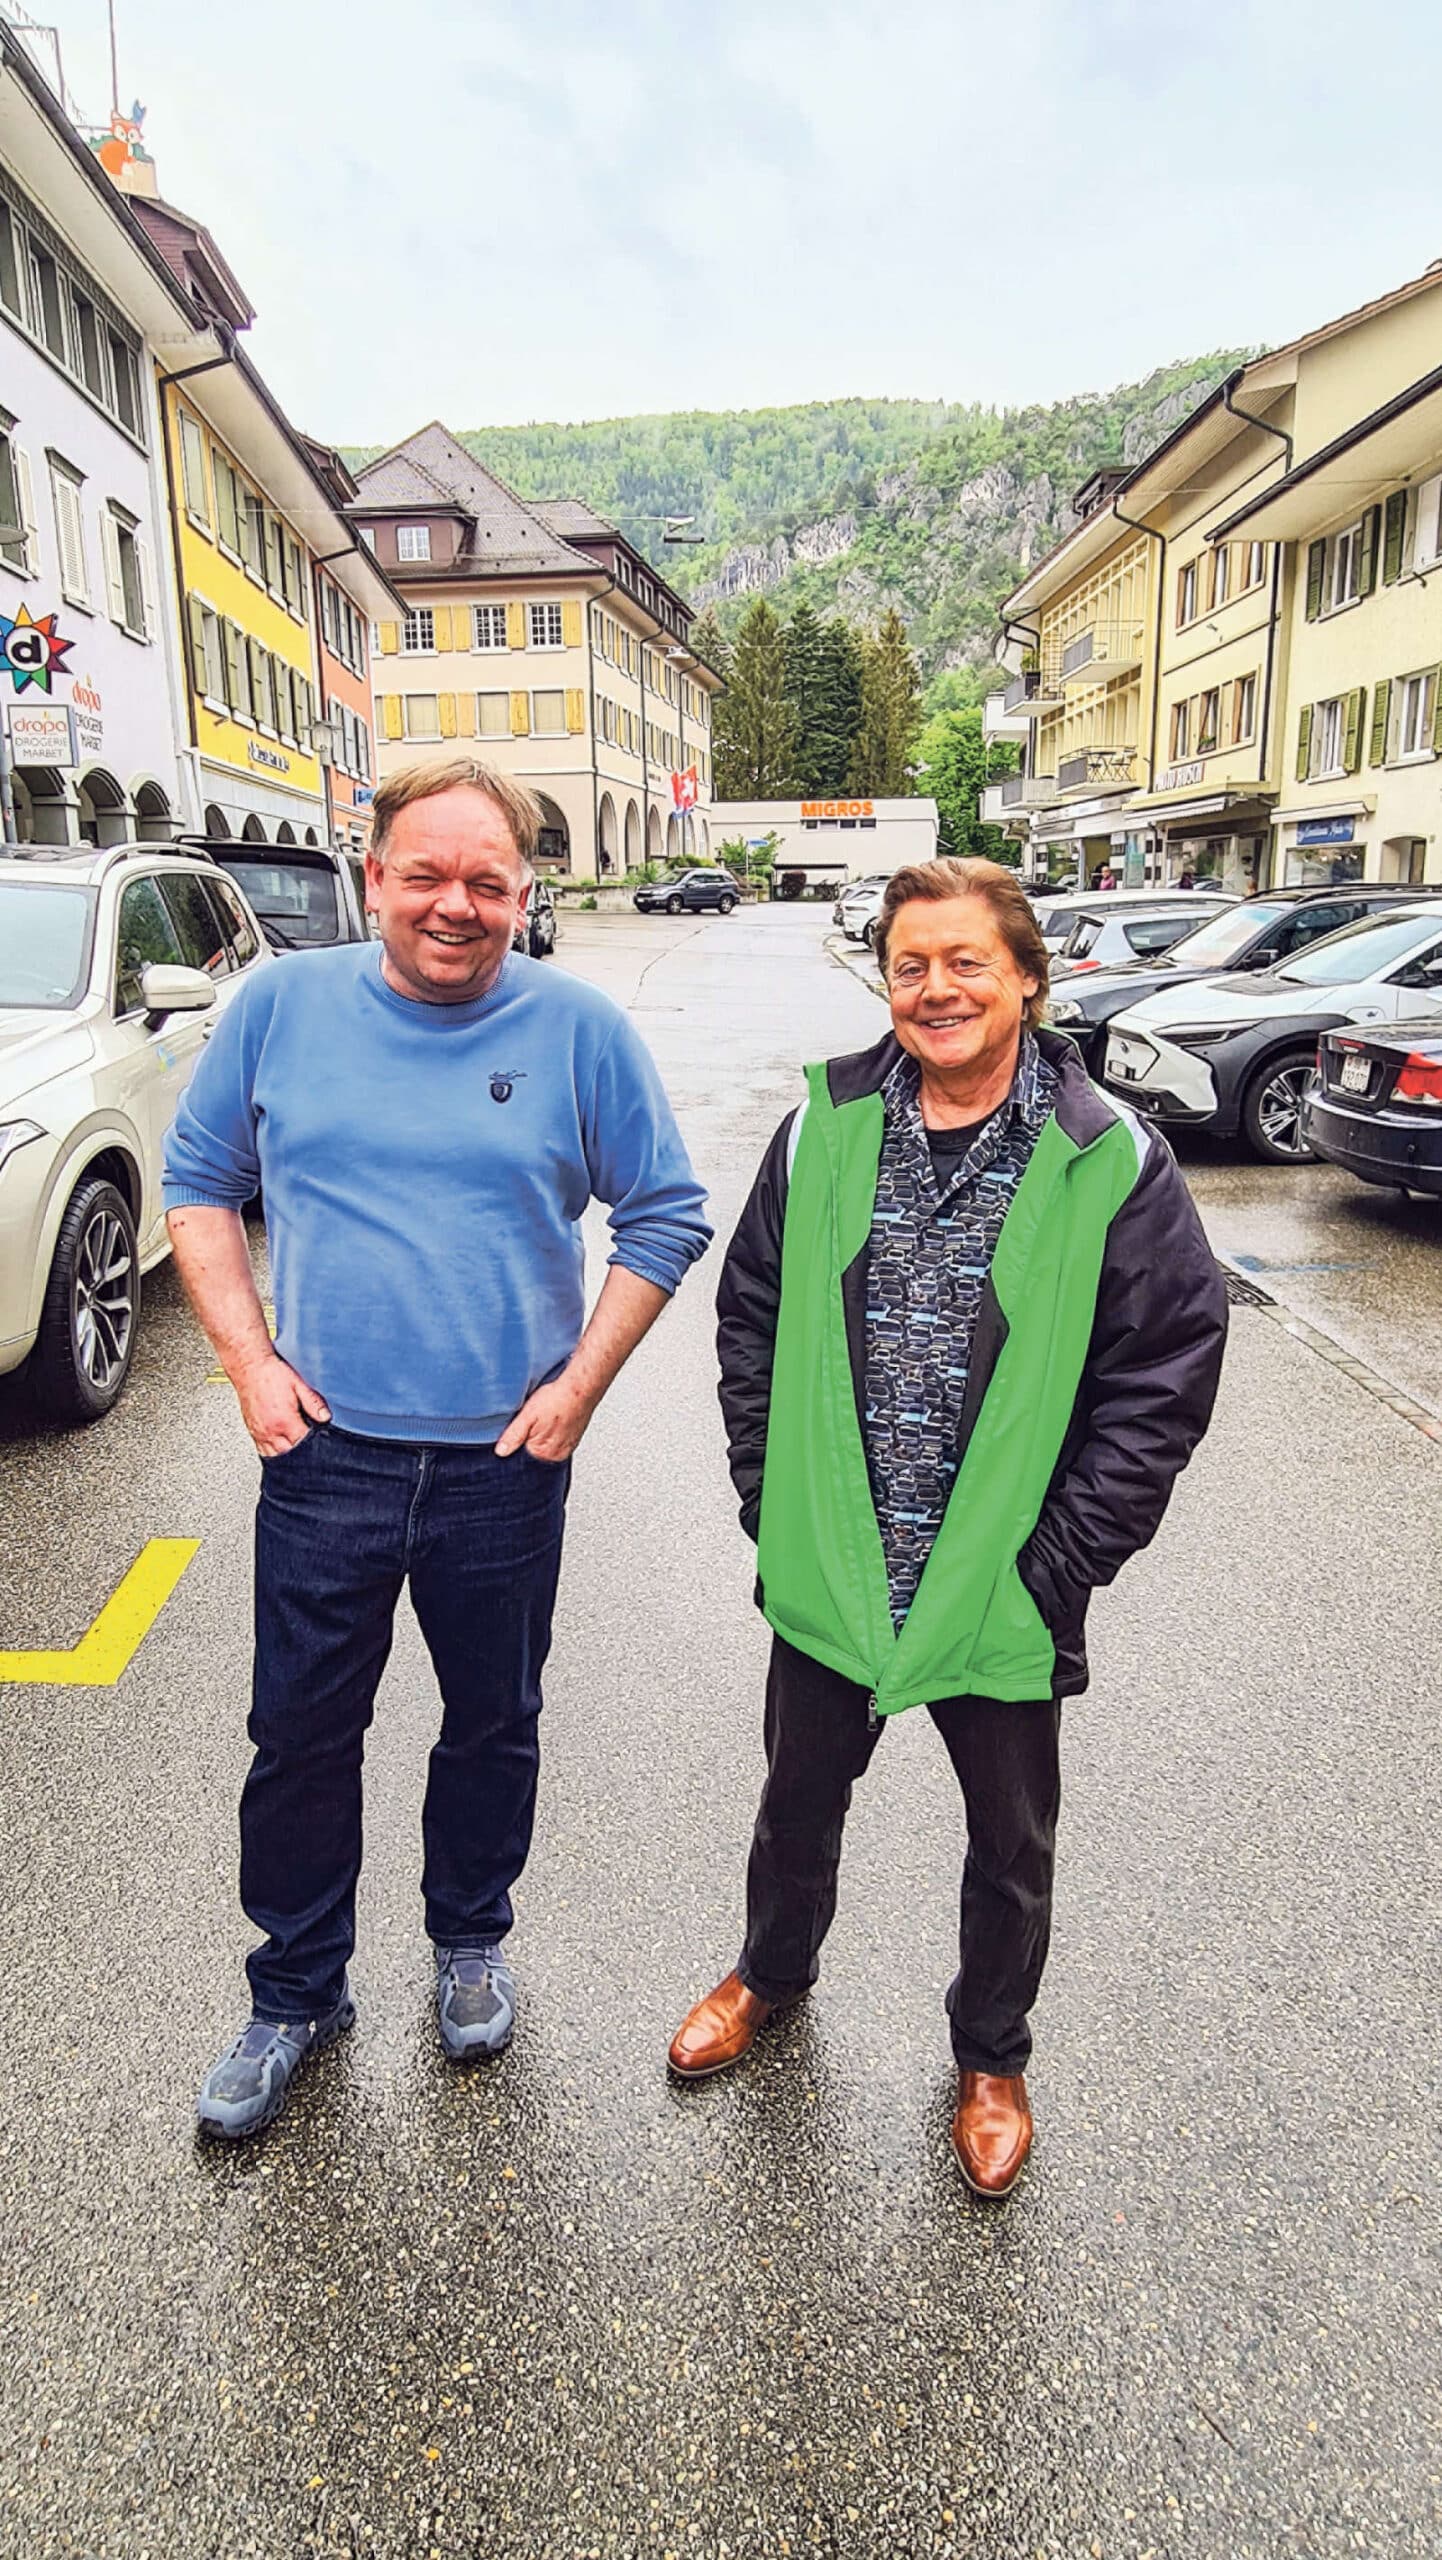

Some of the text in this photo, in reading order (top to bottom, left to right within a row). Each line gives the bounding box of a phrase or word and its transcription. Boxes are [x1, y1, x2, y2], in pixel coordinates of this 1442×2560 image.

[11, 634, 42, 663] d
[14, 717, 67, 735] dropa
[15, 737, 67, 747] DROGERIE
[801, 801, 874, 816] MIGROS
